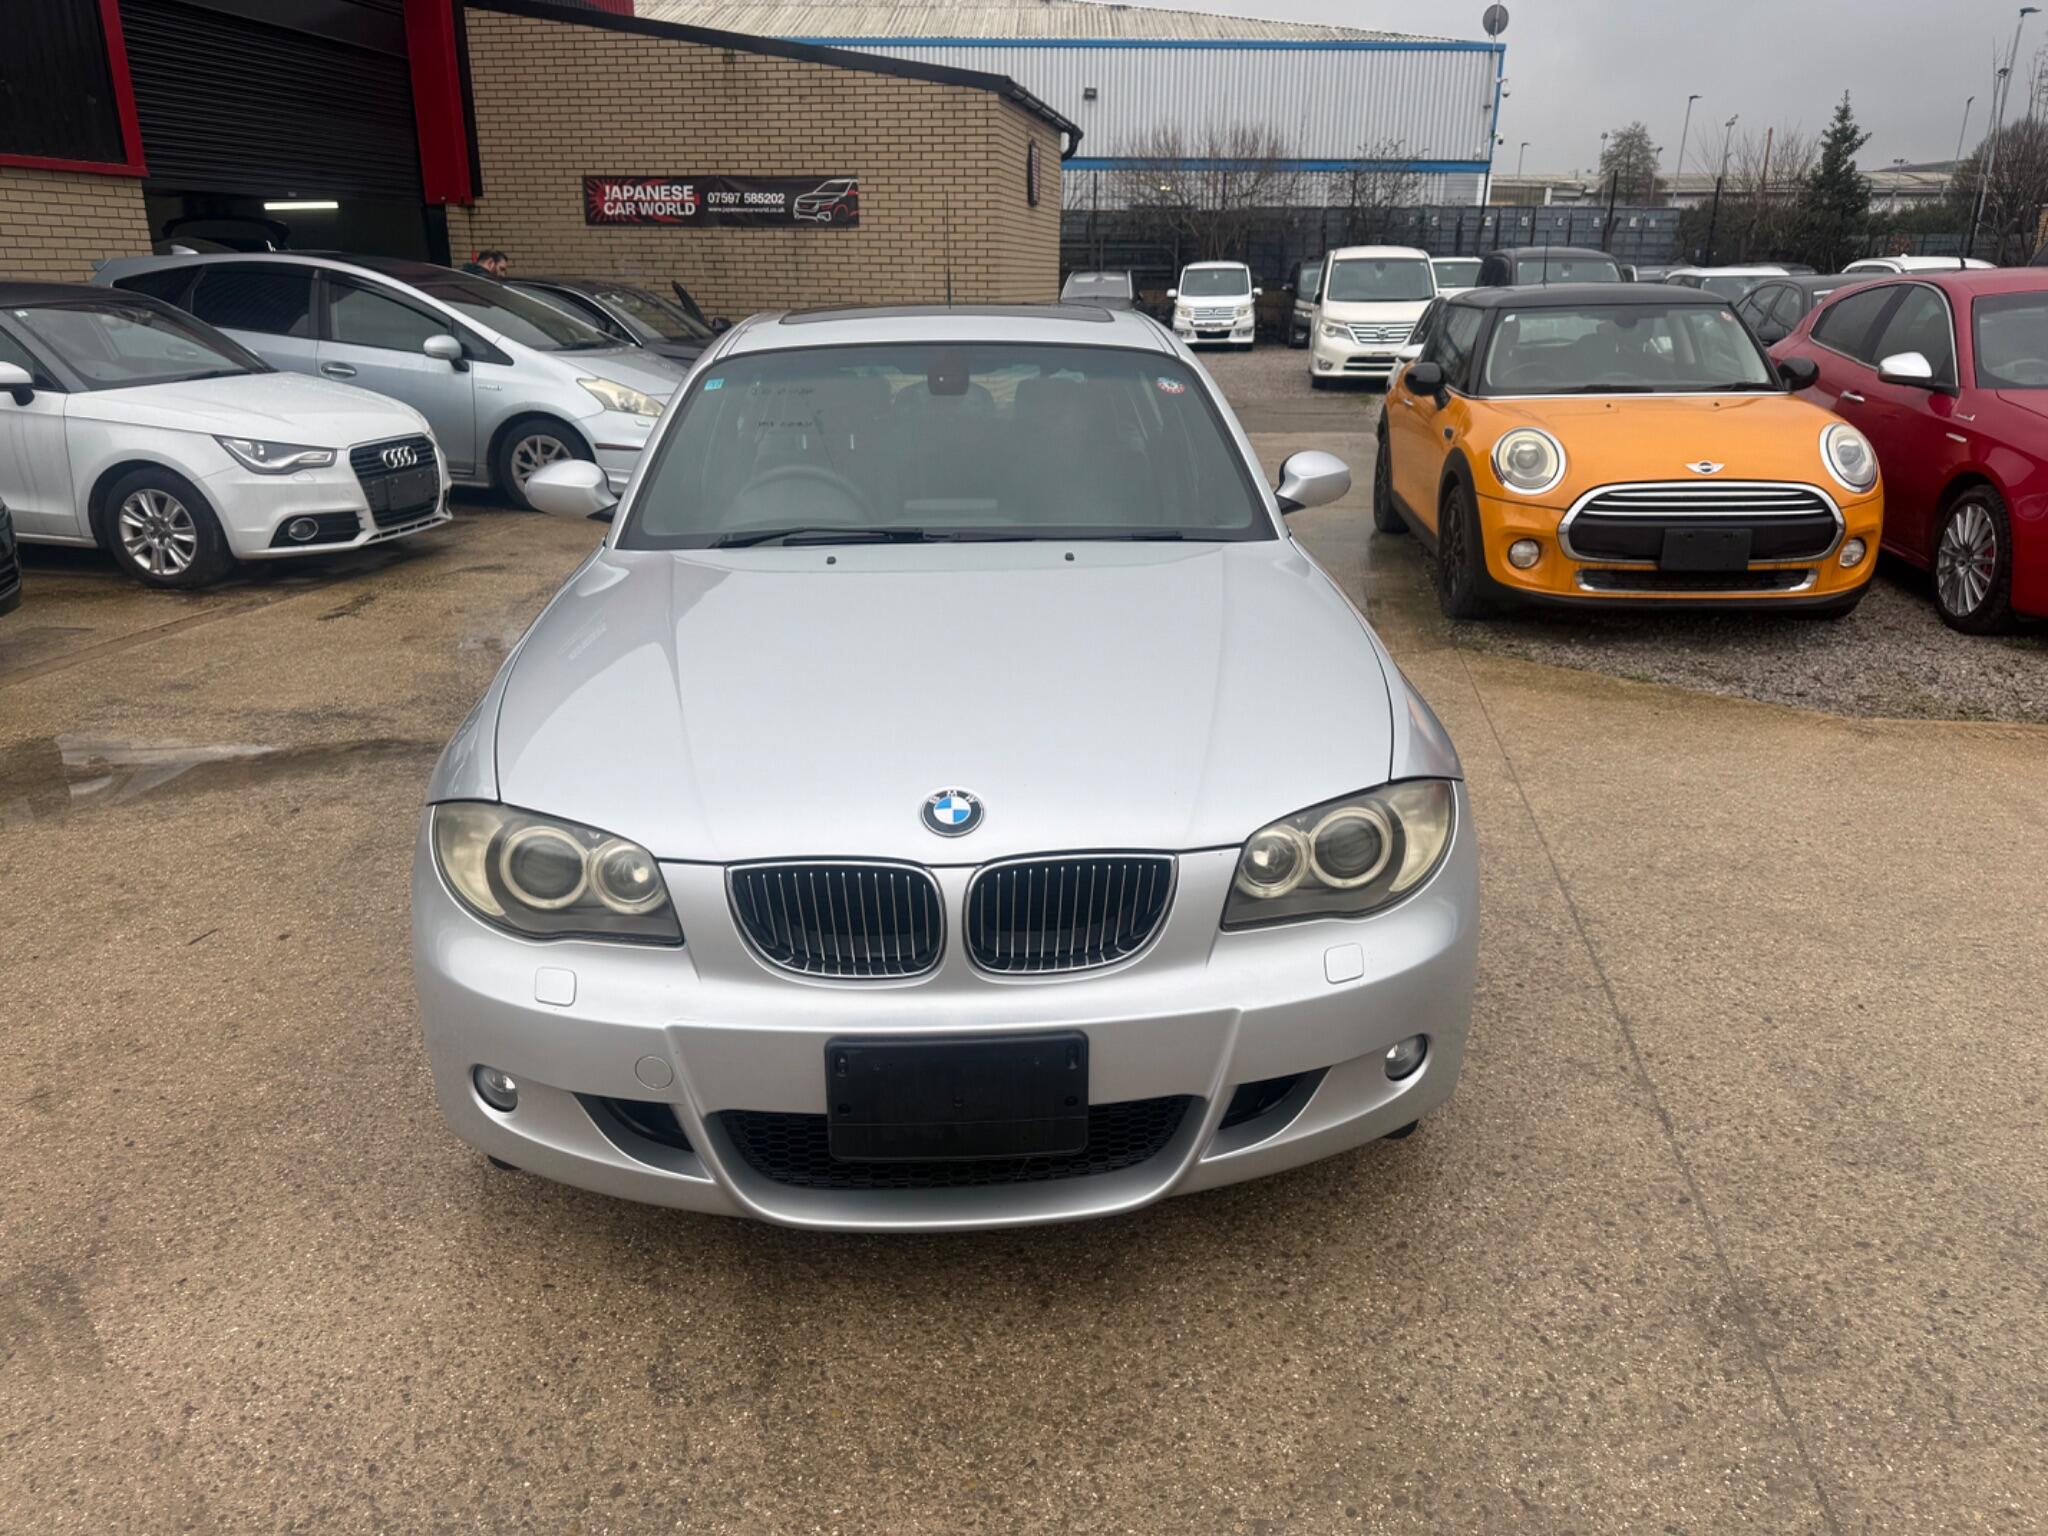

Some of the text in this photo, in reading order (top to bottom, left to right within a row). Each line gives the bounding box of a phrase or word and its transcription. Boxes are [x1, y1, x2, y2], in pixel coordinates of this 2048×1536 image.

[604, 185, 695, 200] JAPANESE
[707, 192, 785, 205] 07597 585202
[603, 201, 696, 216] CAR WORLD
[928, 789, 978, 804] BMW
